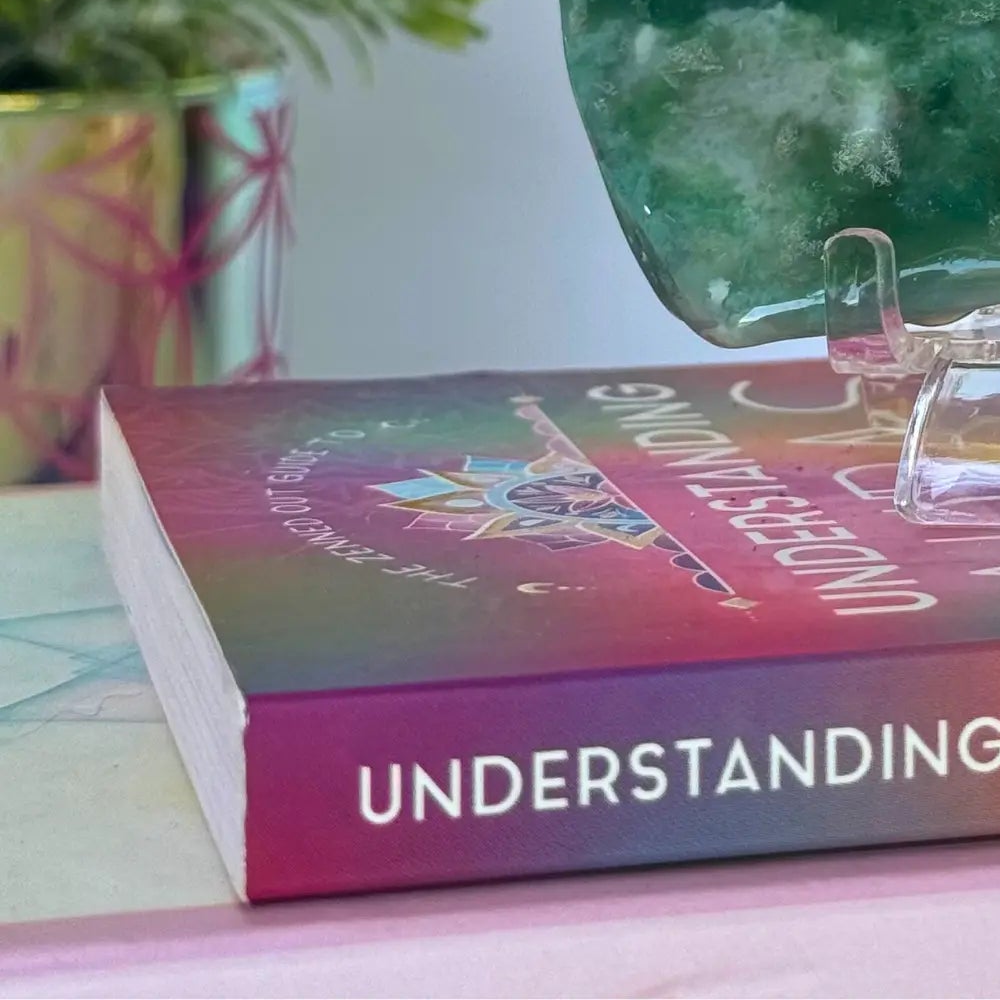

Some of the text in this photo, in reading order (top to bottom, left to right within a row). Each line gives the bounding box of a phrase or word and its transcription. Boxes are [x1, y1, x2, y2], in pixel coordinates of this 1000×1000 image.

[265, 428, 479, 588] THE ZENNED OUT GUIDE TO
[586, 381, 939, 616] UNDERSTANDING
